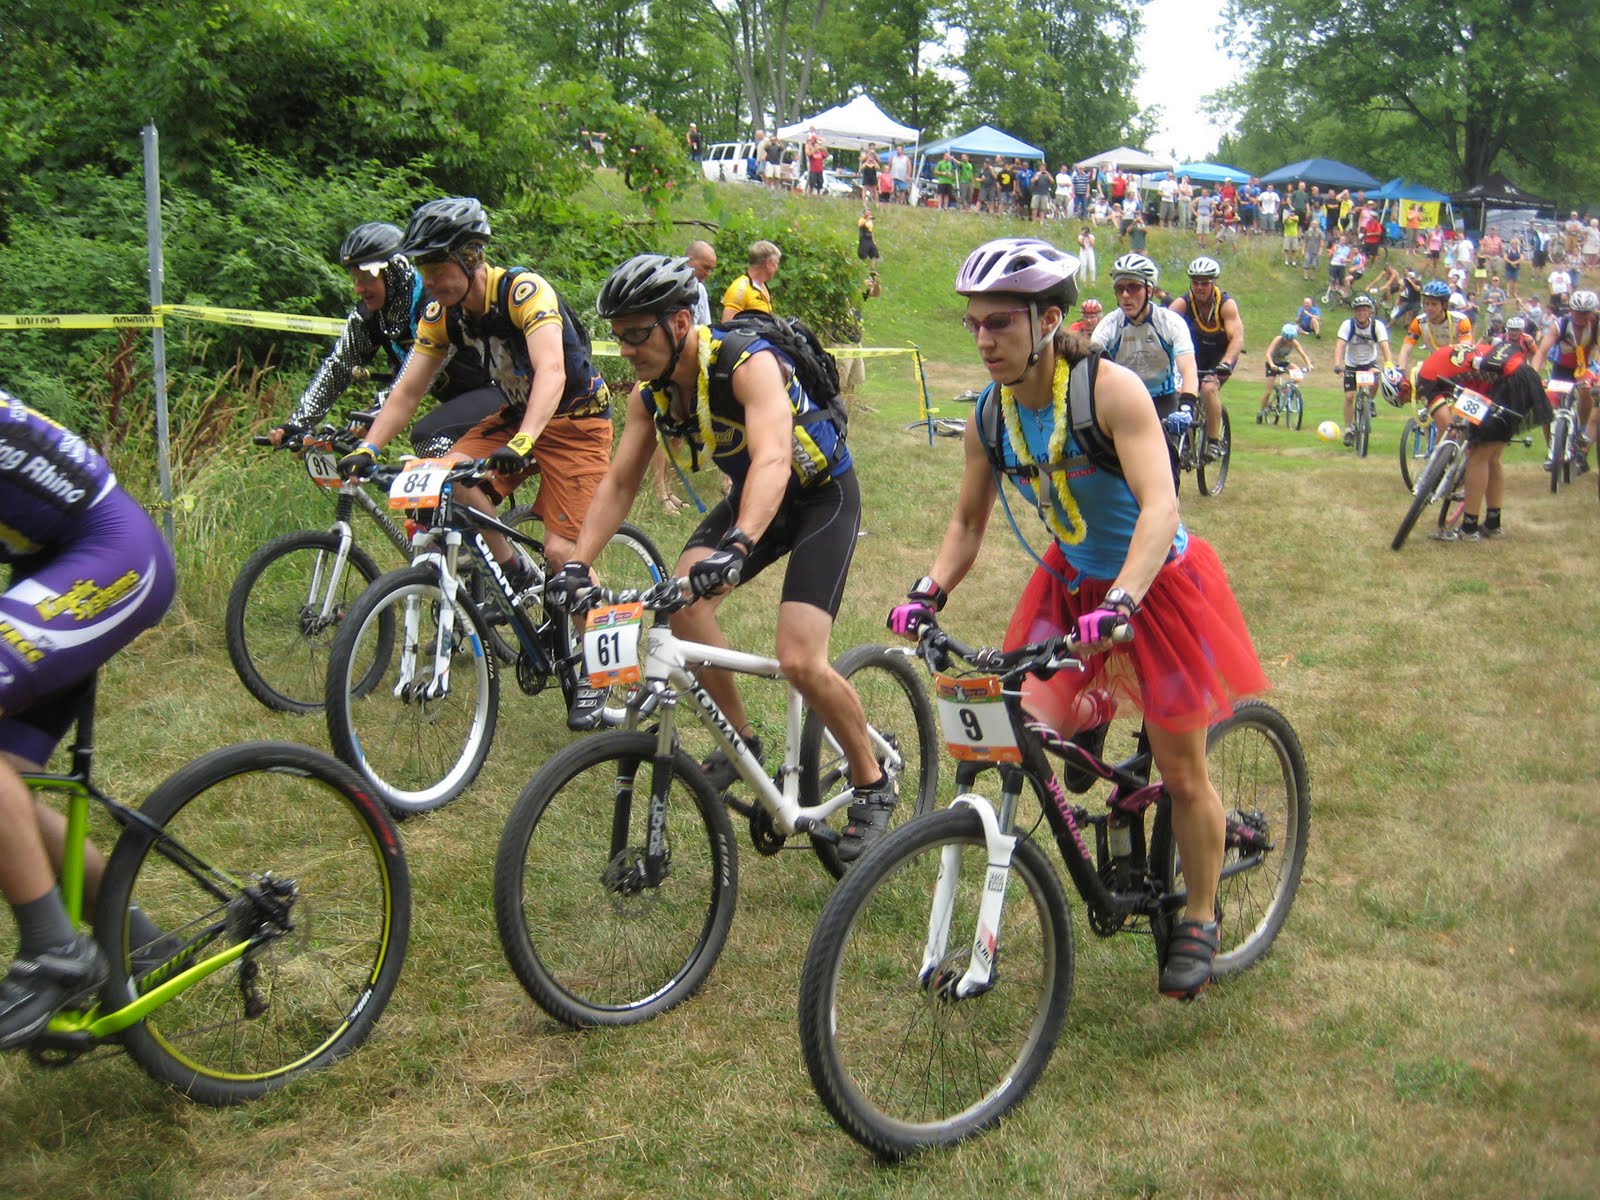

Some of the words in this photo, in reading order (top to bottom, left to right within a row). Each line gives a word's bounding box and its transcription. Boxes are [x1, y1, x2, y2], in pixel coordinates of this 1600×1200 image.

[1463, 400, 1479, 415] 38
[20, 456, 86, 503] Rhino
[311, 456, 330, 476] 91
[403, 473, 432, 493] 84
[372, 506, 415, 557] CANNOND
[597, 631, 620, 667] 61
[959, 708, 983, 741] 9
